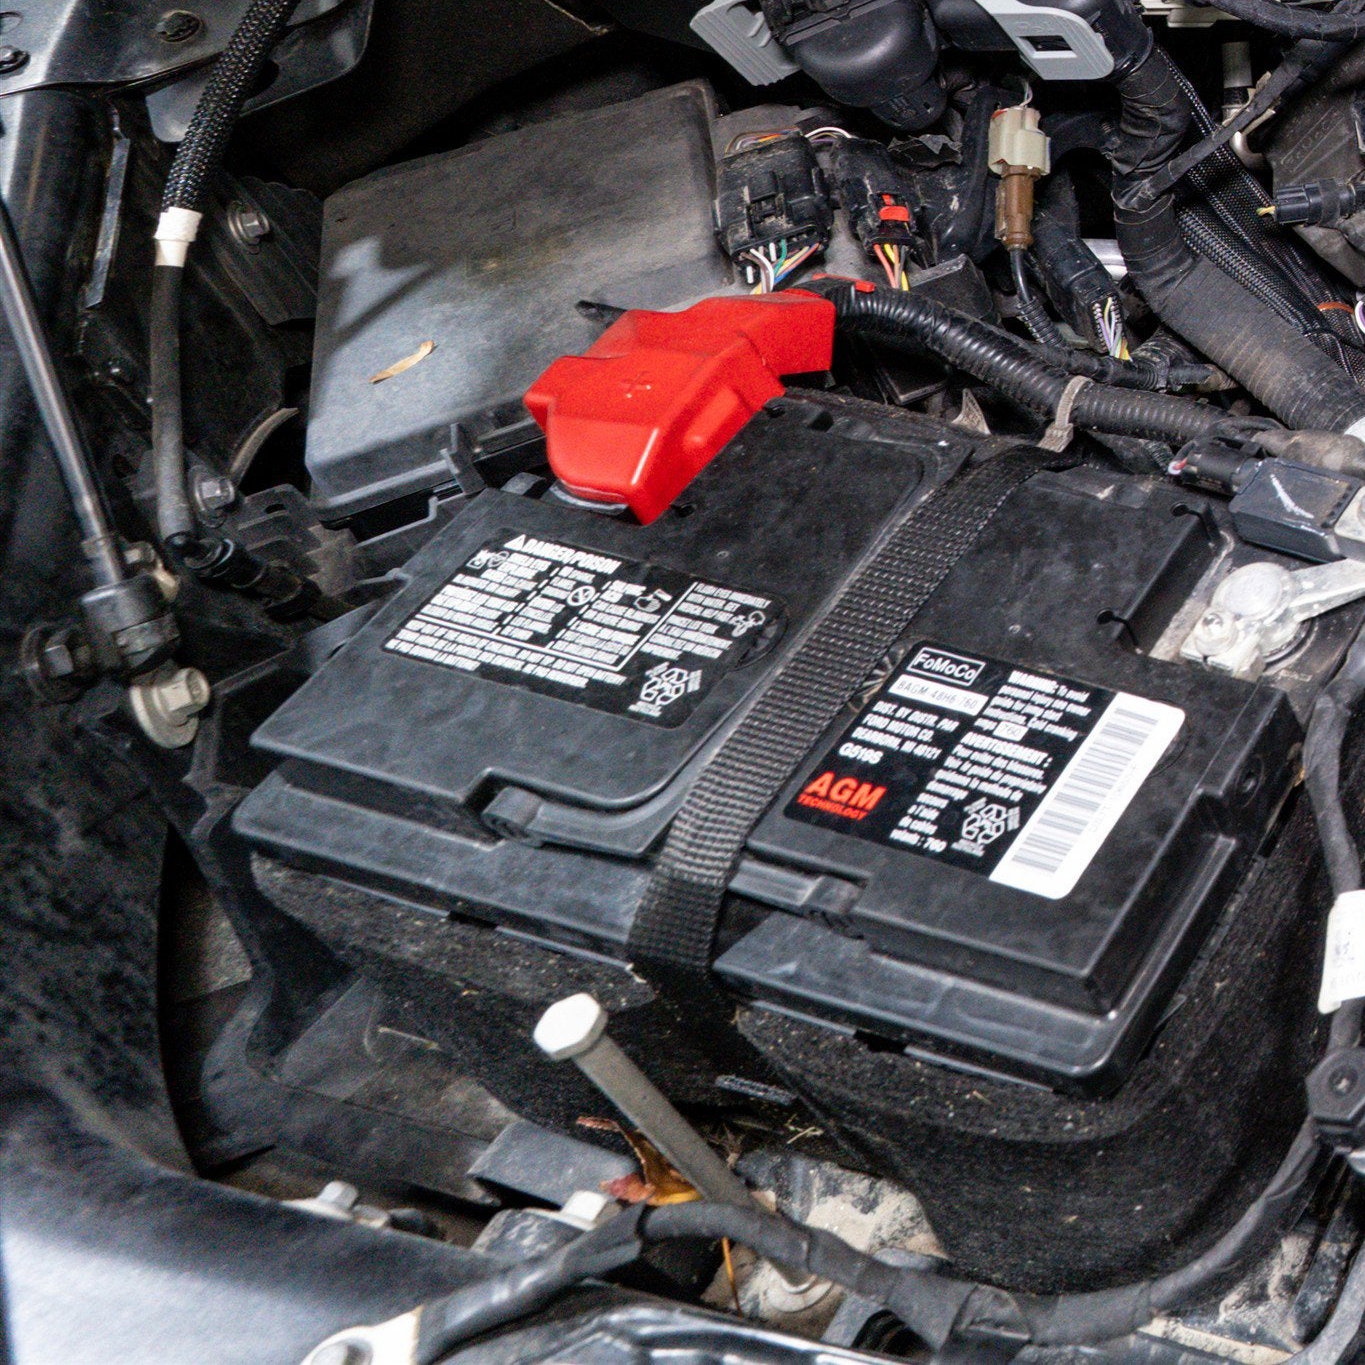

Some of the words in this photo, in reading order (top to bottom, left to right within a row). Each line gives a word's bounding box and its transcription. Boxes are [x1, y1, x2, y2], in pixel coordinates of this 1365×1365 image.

[522, 538, 622, 575] DANGER/POISON
[913, 654, 978, 680] FoMoCo
[1007, 671, 1060, 694] WARNING:
[1057, 685, 1069, 696] To
[1066, 688, 1090, 702] avoid
[1031, 692, 1055, 706] injury
[862, 713, 890, 729] FORD
[886, 720, 921, 737] MOTOR
[917, 728, 936, 742] CO.
[872, 701, 897, 715] DIST.
[895, 706, 912, 719] BY
[937, 717, 959, 732] PAR
[1027, 717, 1047, 730] Cold
[1043, 723, 1078, 740] cranking
[851, 728, 904, 749] DEARBORN,
[1001, 725, 1022, 735] 760
[806, 772, 887, 808] AGM
[796, 793, 867, 820] TECHNOLOGY
[922, 837, 948, 852] 760
